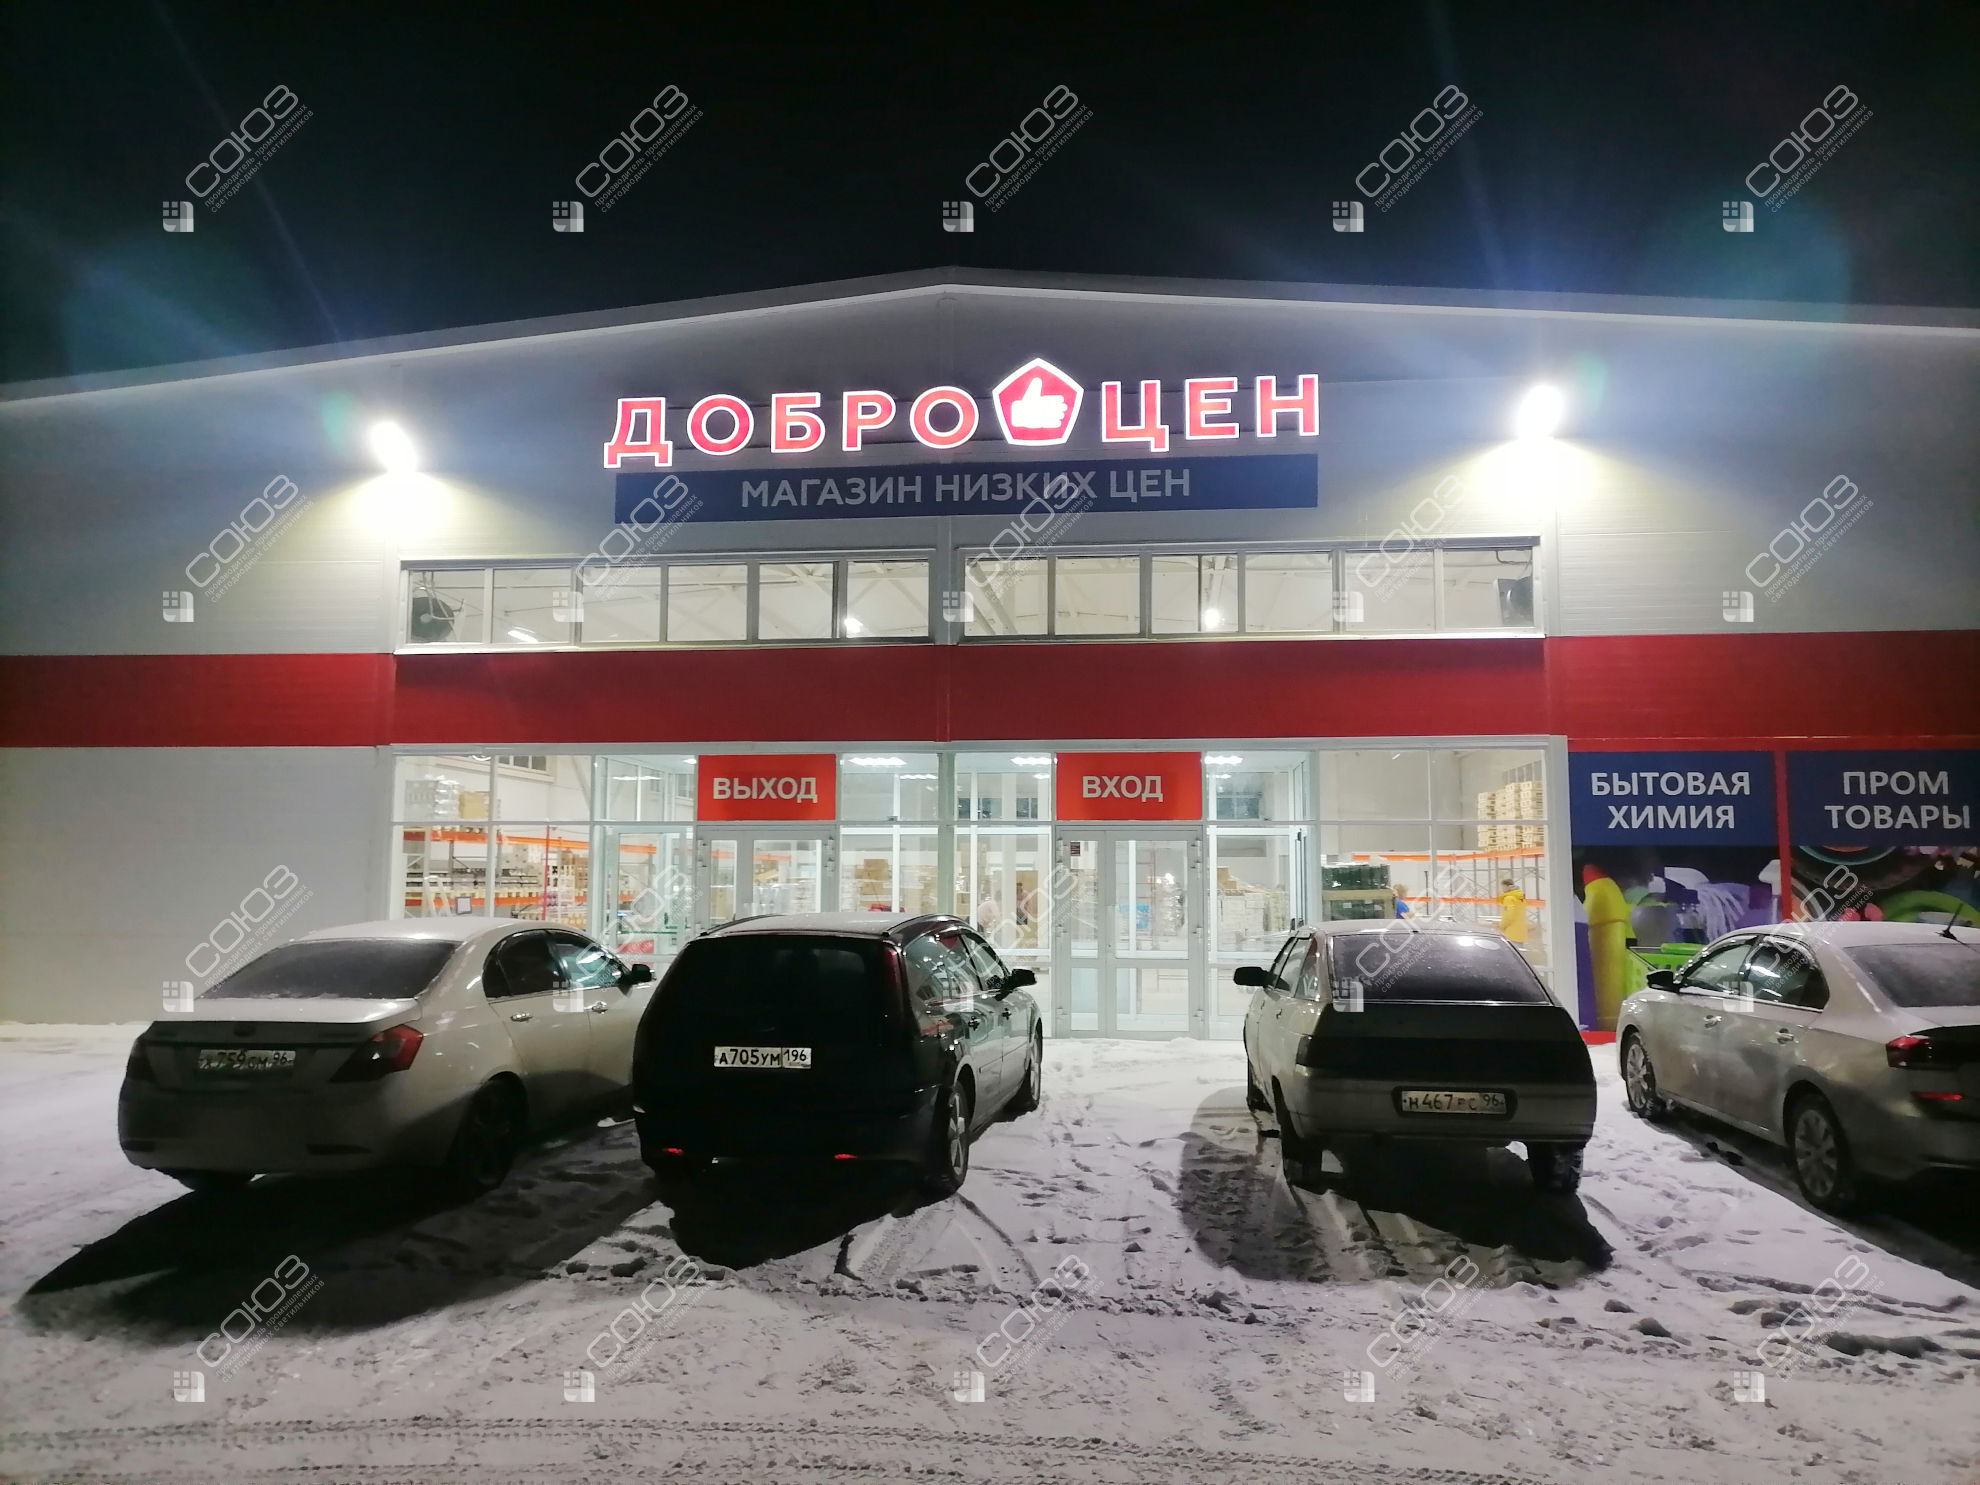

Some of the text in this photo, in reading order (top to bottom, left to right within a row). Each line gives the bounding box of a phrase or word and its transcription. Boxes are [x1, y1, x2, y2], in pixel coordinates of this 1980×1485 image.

[604, 374, 1320, 469] ДОБРО ЦЕН
[741, 469, 1191, 508] МАГАЗИН НИЗКИХ ЦЕН
[713, 777, 818, 804] ВЫХОД
[1082, 775, 1163, 803] ВХОД
[1591, 772, 1751, 796] БЫТОВАЯ
[1843, 771, 1950, 795] ПРОМ
[1607, 805, 1736, 829] ХИМИЯ
[1824, 805, 1971, 829] ТОВАРЫ
